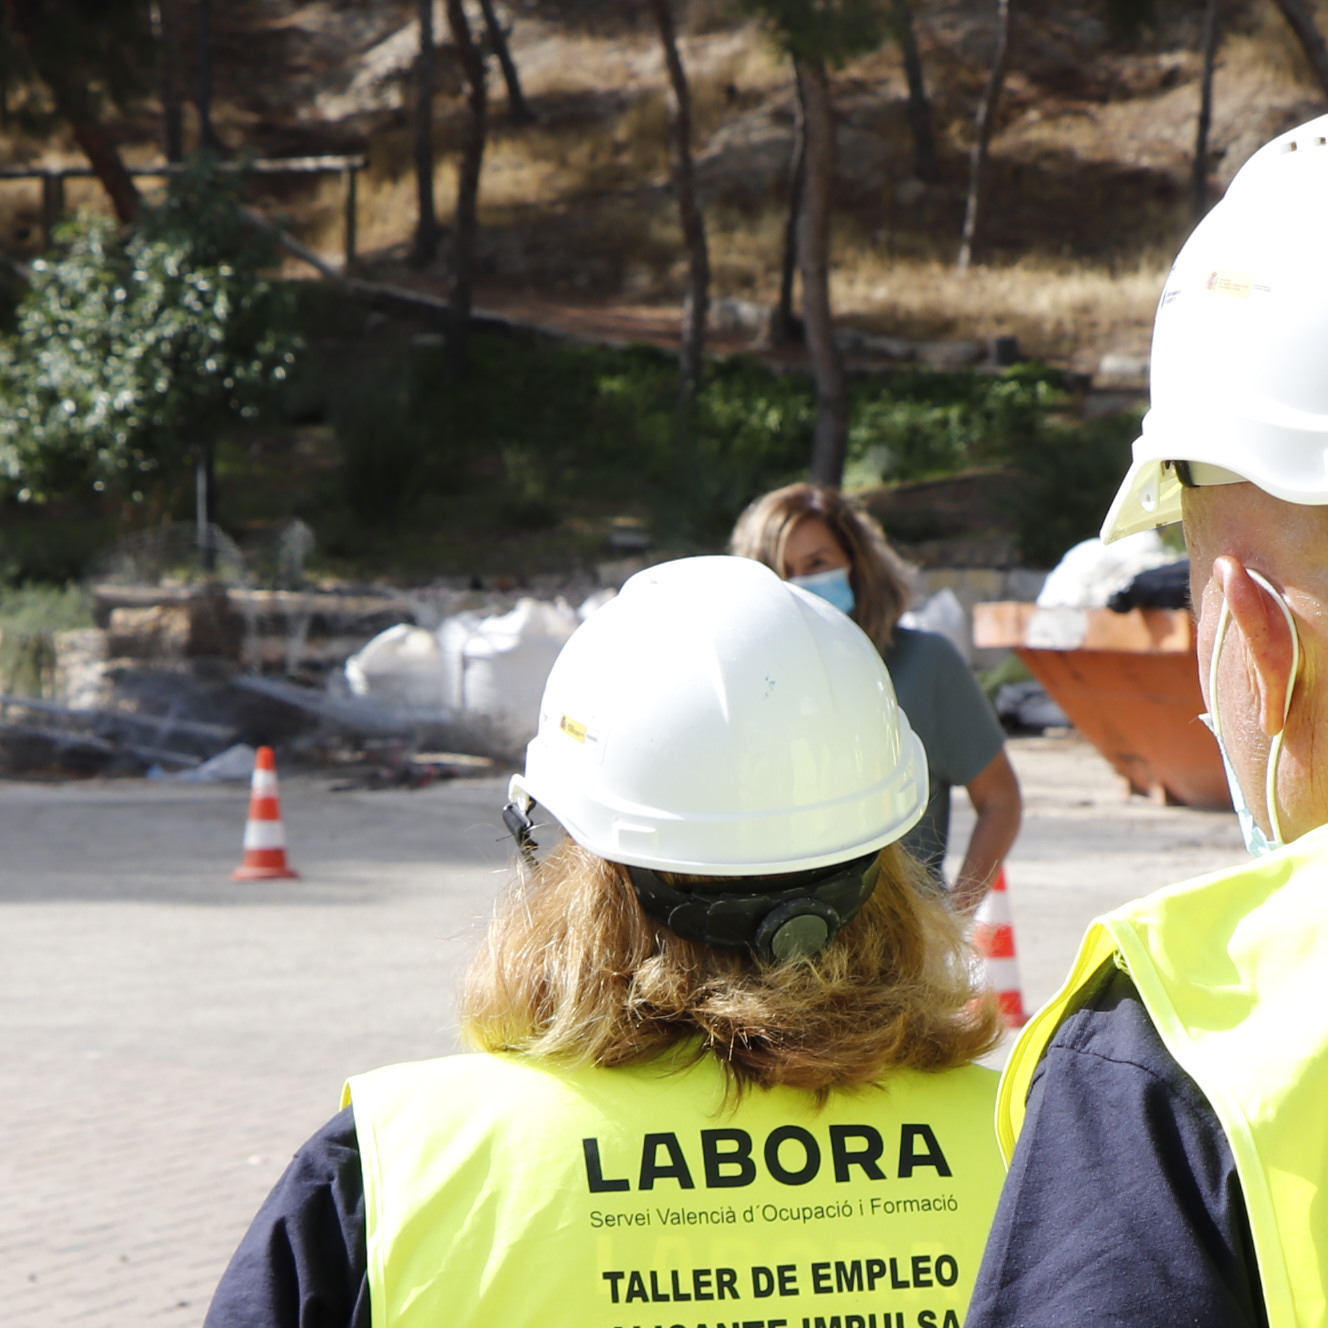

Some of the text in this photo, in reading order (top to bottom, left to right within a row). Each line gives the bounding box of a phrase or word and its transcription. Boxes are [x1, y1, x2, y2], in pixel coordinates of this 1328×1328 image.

[582, 1123, 953, 1193] LABORA
[590, 1209, 651, 1228] Servei
[656, 1205, 737, 1226] Valencià
[859, 1200, 864, 1216] i
[871, 1194, 958, 1216] Formació
[603, 1254, 959, 1303] TALLER DE EMPLEO
